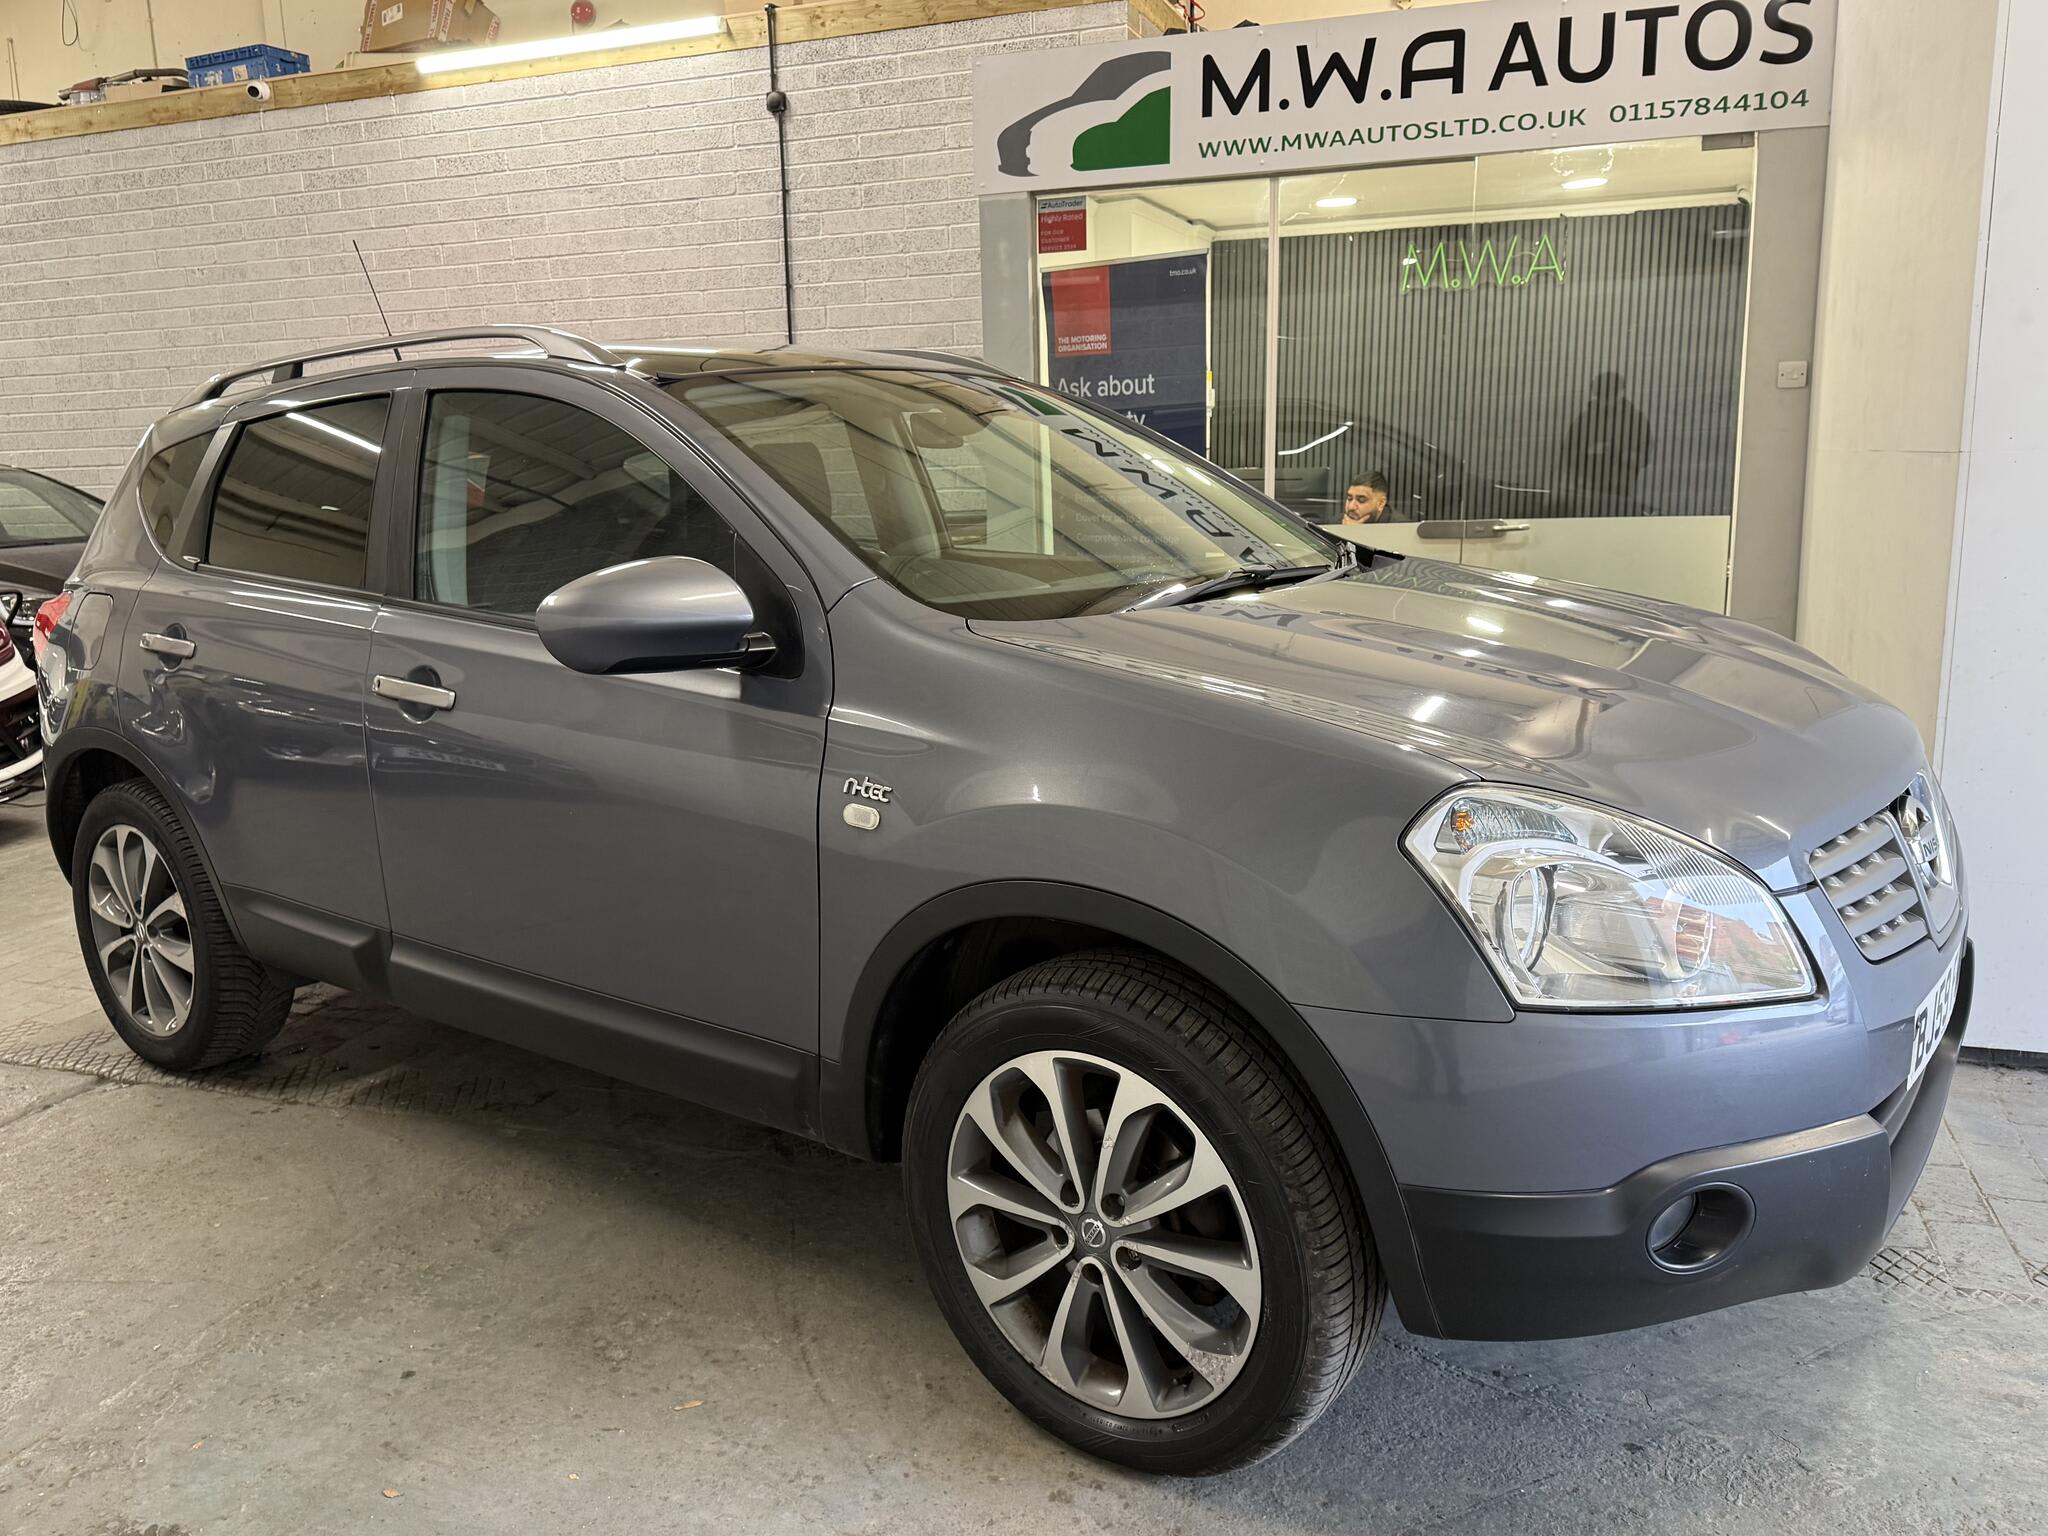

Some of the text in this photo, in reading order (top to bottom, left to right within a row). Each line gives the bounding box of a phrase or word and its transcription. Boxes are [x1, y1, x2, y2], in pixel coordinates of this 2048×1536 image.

[1201, 0, 1814, 118] M.W.A AUTOS
[1198, 88, 1810, 158] WWW.MWAAUTOSLTD.CO.UK 01157844104
[1401, 233, 1565, 293] M.W.A
[1057, 342, 1108, 353] ORGANISATION
[1058, 333, 1107, 345] THE MOTORING
[1058, 373, 1156, 398] Ask about
